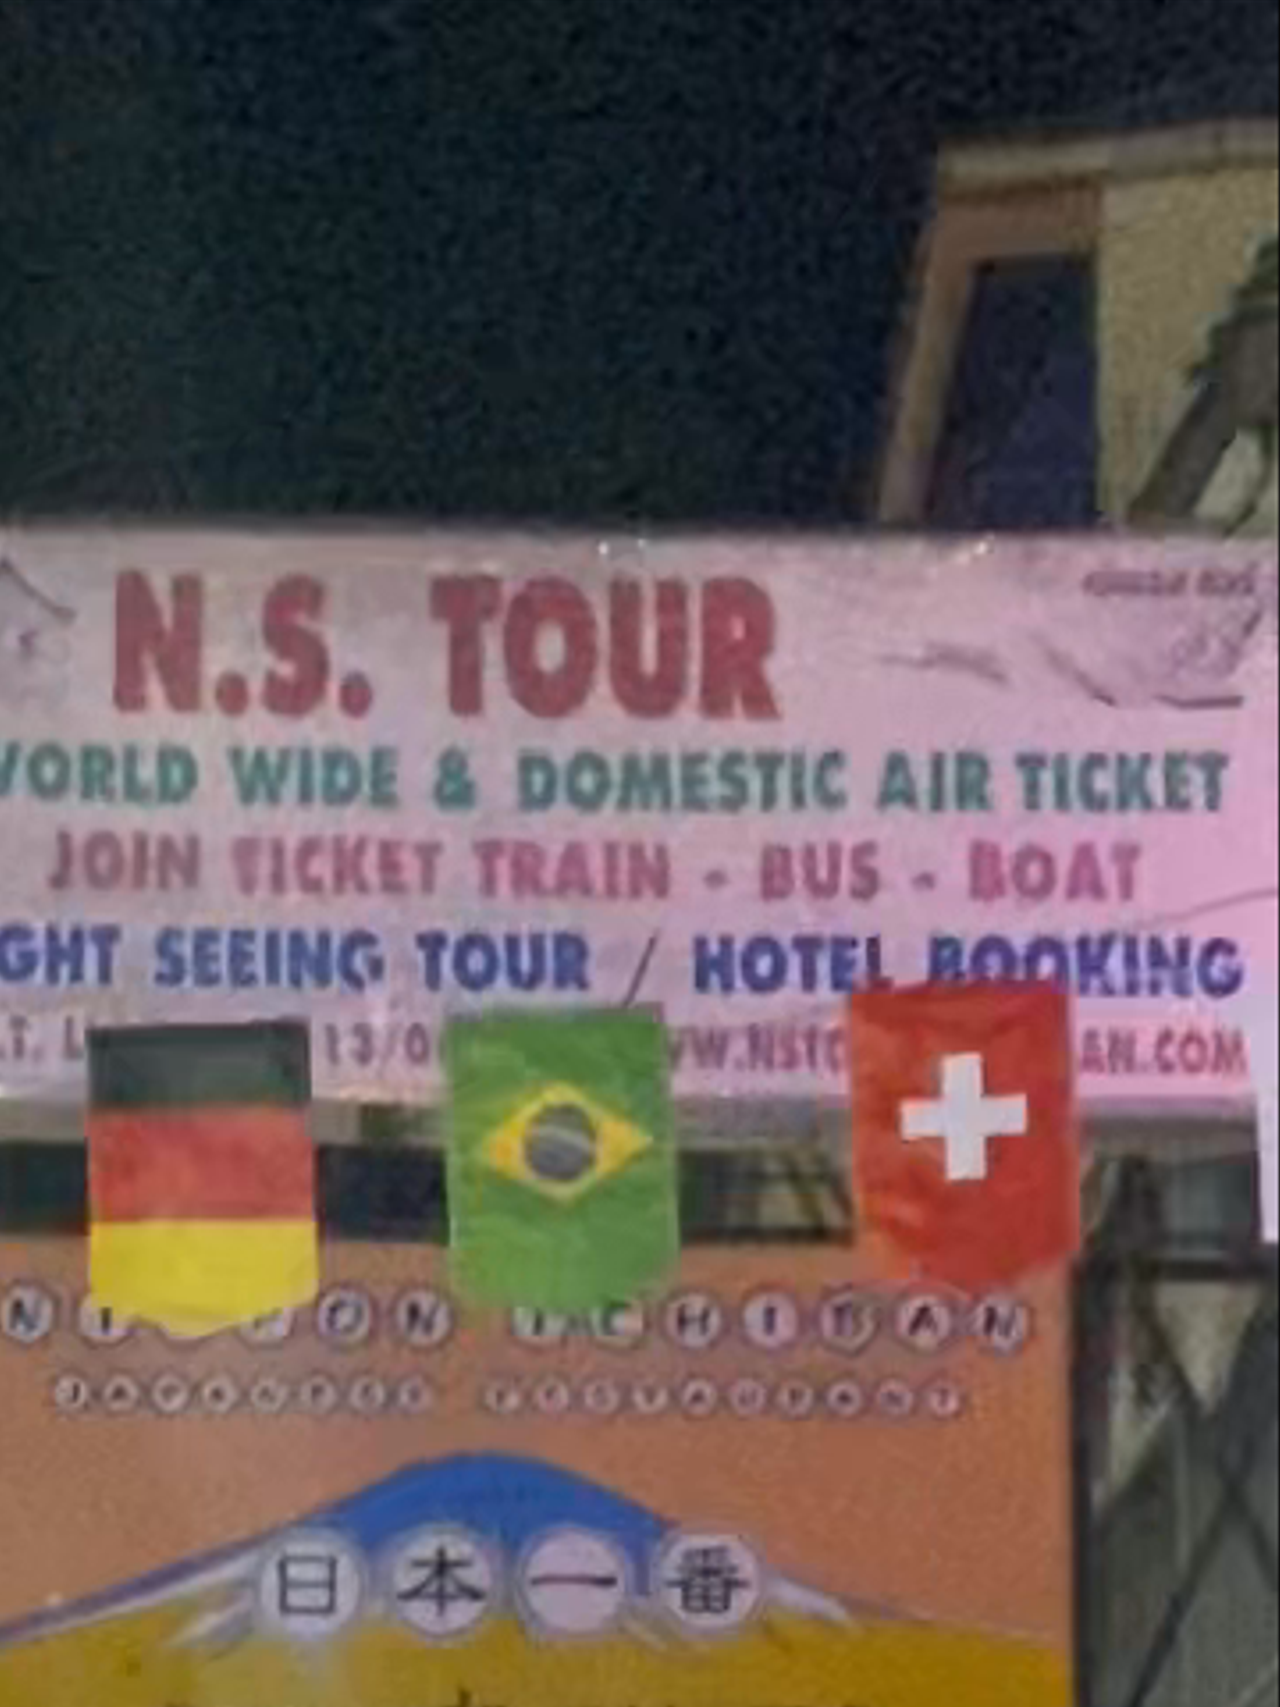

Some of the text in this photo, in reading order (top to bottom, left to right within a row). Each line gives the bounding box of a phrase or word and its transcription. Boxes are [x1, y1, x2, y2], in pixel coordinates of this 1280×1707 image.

[112, 570, 782, 720] N.S. TOUR
[228, 746, 398, 807] WIDE
[433, 750, 476, 810] &
[516, 748, 847, 812] DOMESTIC
[876, 752, 993, 813] AIR
[1014, 752, 1229, 813] TICKET
[49, 829, 200, 892] JOIN
[230, 834, 444, 896] TICKET
[472, 838, 671, 900] TRAIN
[759, 842, 881, 900] BUS
[968, 840, 1142, 900] BOAT
[152, 925, 385, 990] SEEING
[416, 931, 591, 992] TOUR
[691, 934, 893, 994] HOTEL
[926, 935, 1245, 998] BOOKING
[278, 1544, 751, 1616] 日本一番
